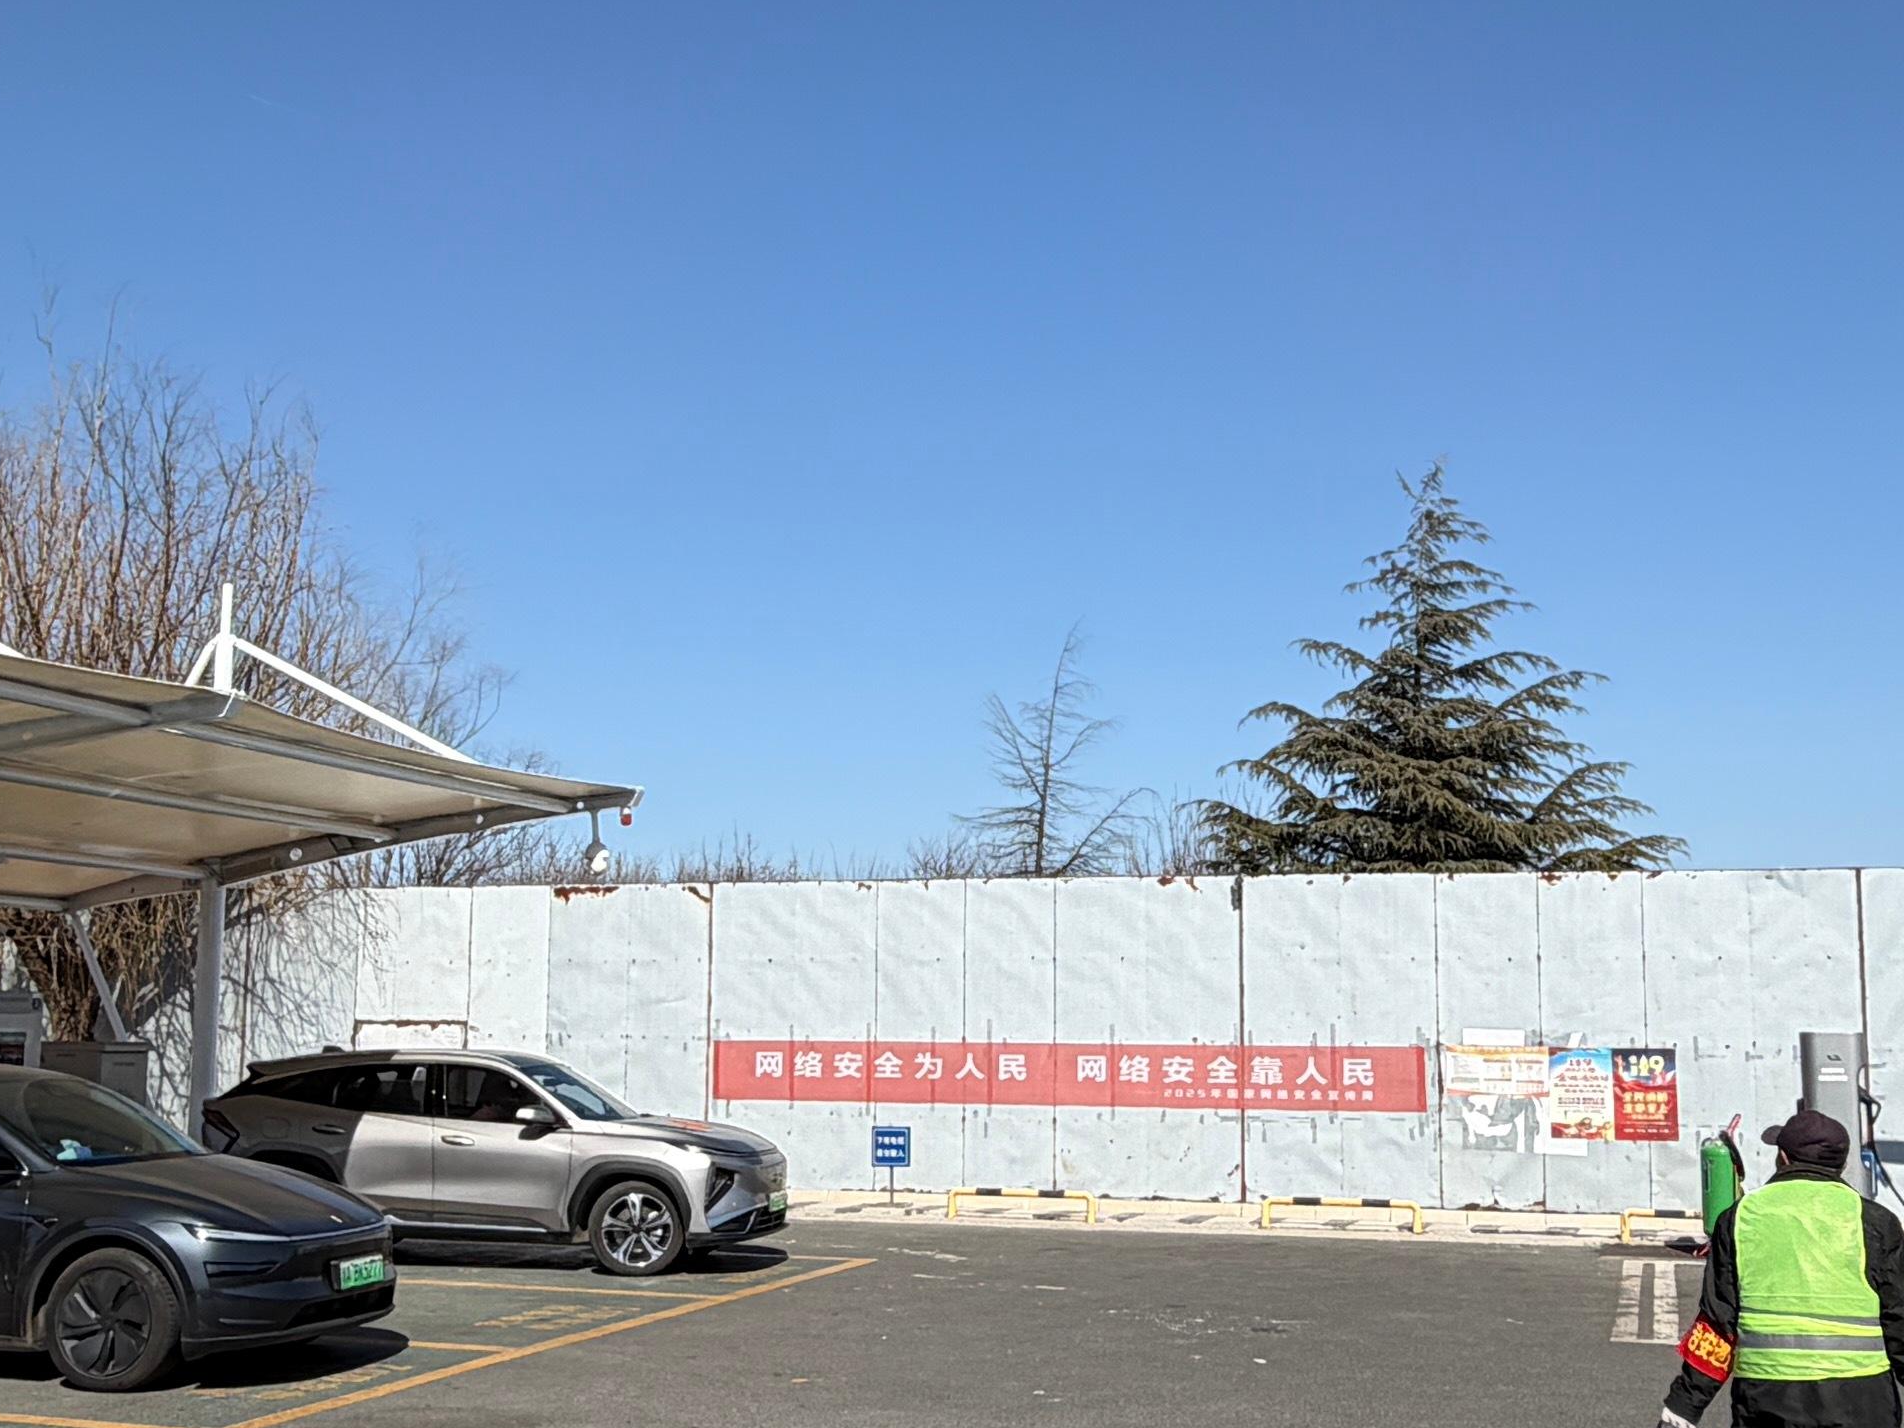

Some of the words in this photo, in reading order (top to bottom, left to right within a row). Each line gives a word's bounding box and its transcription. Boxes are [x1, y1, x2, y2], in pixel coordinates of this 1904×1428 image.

[755, 1051, 1027, 1081] 网络安全为人民
[1077, 1055, 1375, 1086] 网络安全靠人民
